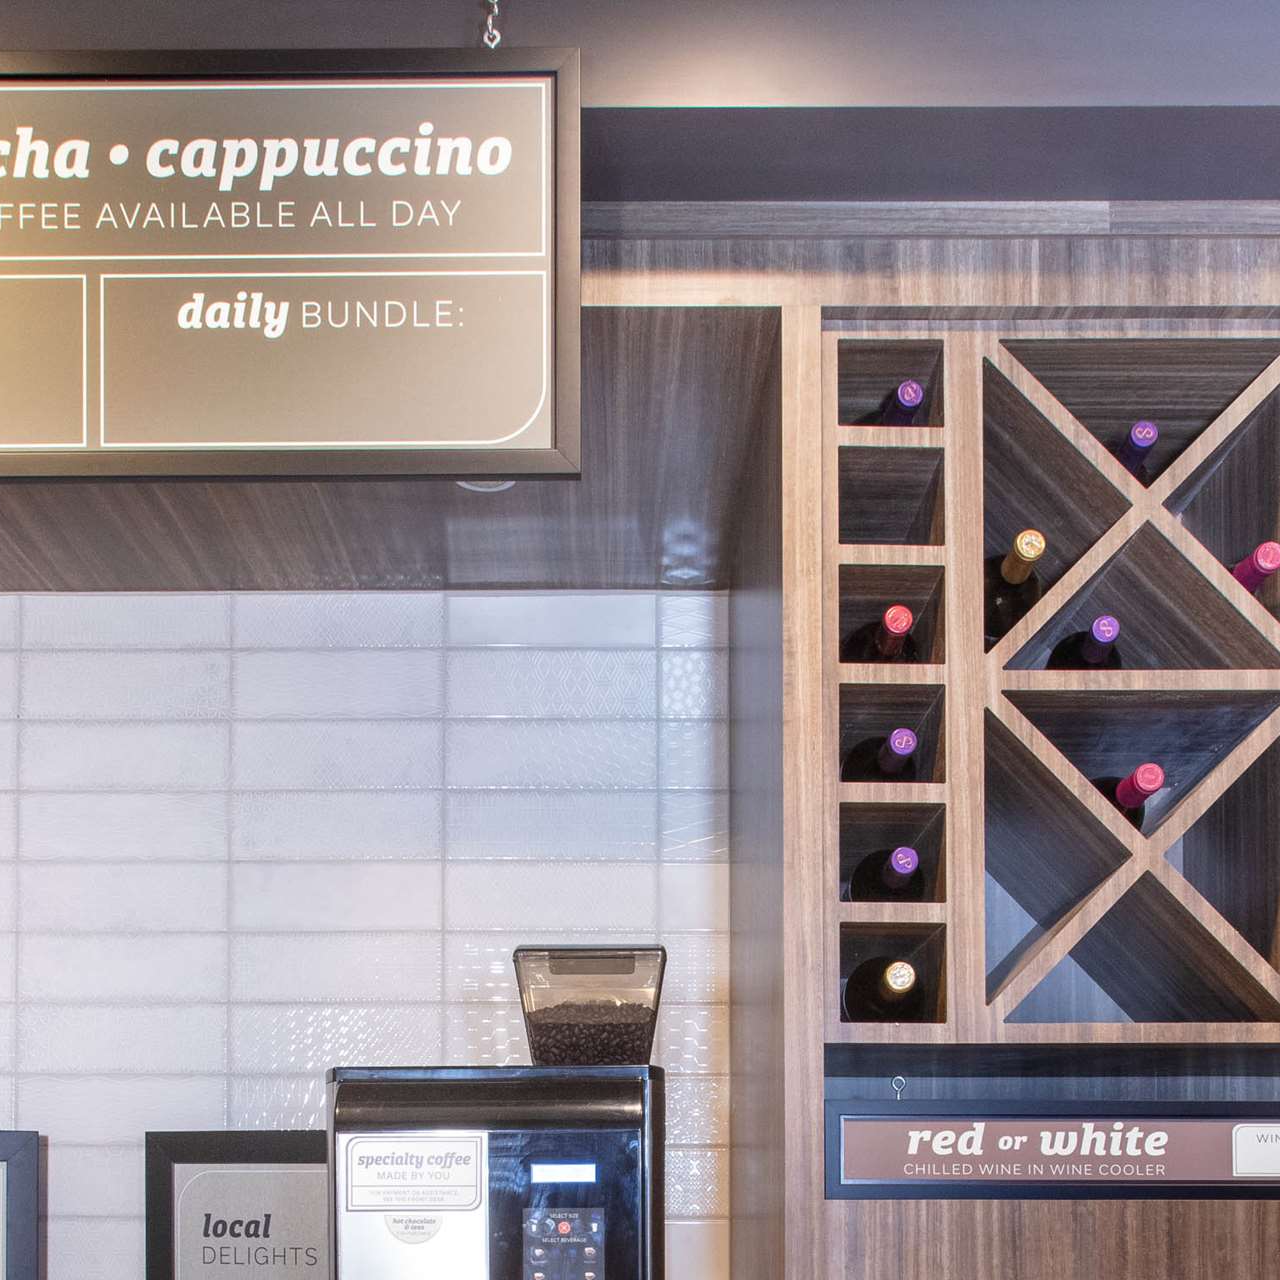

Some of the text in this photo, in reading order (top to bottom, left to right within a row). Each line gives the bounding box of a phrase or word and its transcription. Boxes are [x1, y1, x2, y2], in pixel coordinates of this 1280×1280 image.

[145, 121, 513, 192] cappuccino
[95, 201, 296, 230] AVAILABLE
[310, 201, 377, 228] ALL
[391, 200, 462, 227] DAY
[177, 291, 464, 339] daily BUNDLE:
[907, 1121, 1169, 1157] red or white
[357, 1151, 472, 1169] specialty coffee
[903, 1163, 1167, 1176] CHILLED WINE IN WINE COOLER
[376, 1171, 451, 1180] MADE BY YOU
[202, 1212, 272, 1239] local
[201, 1244, 318, 1267] DELIGHTS
